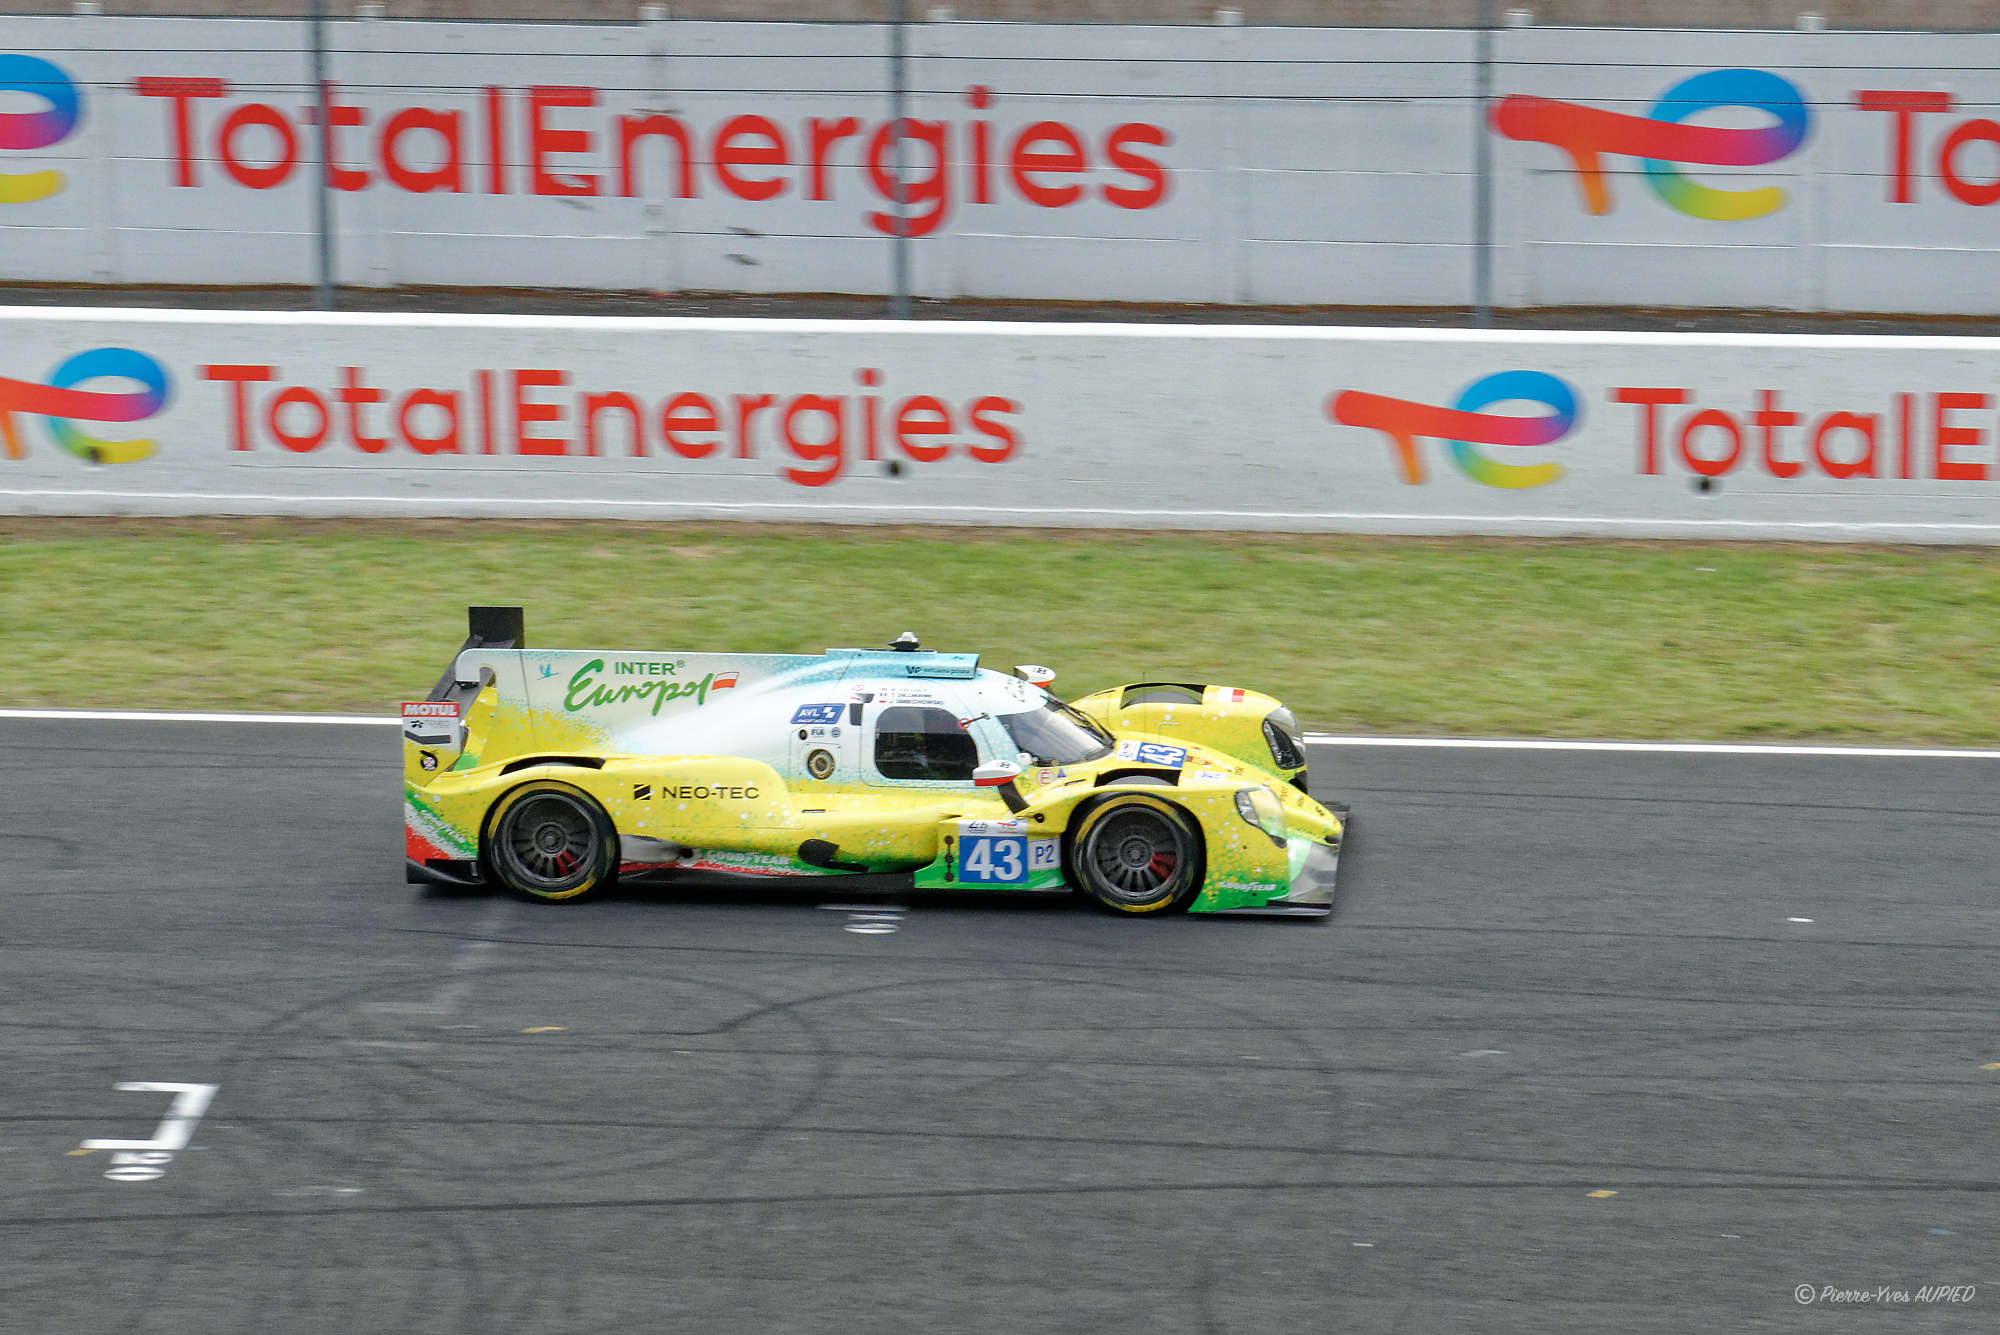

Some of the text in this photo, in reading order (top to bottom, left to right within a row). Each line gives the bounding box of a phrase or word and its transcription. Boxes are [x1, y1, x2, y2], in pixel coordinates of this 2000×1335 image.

[134, 77, 1169, 237] TotalEnergies
[201, 365, 1020, 486] TotalEnergies
[564, 658, 714, 716] Europol
[404, 704, 458, 716] MOTUL
[798, 708, 820, 717] AVL
[811, 728, 825, 736] FIA
[1139, 744, 1184, 766] 43
[662, 786, 759, 800] NEO-TEC
[965, 838, 1023, 881] 43
[1035, 843, 1054, 865] P2
